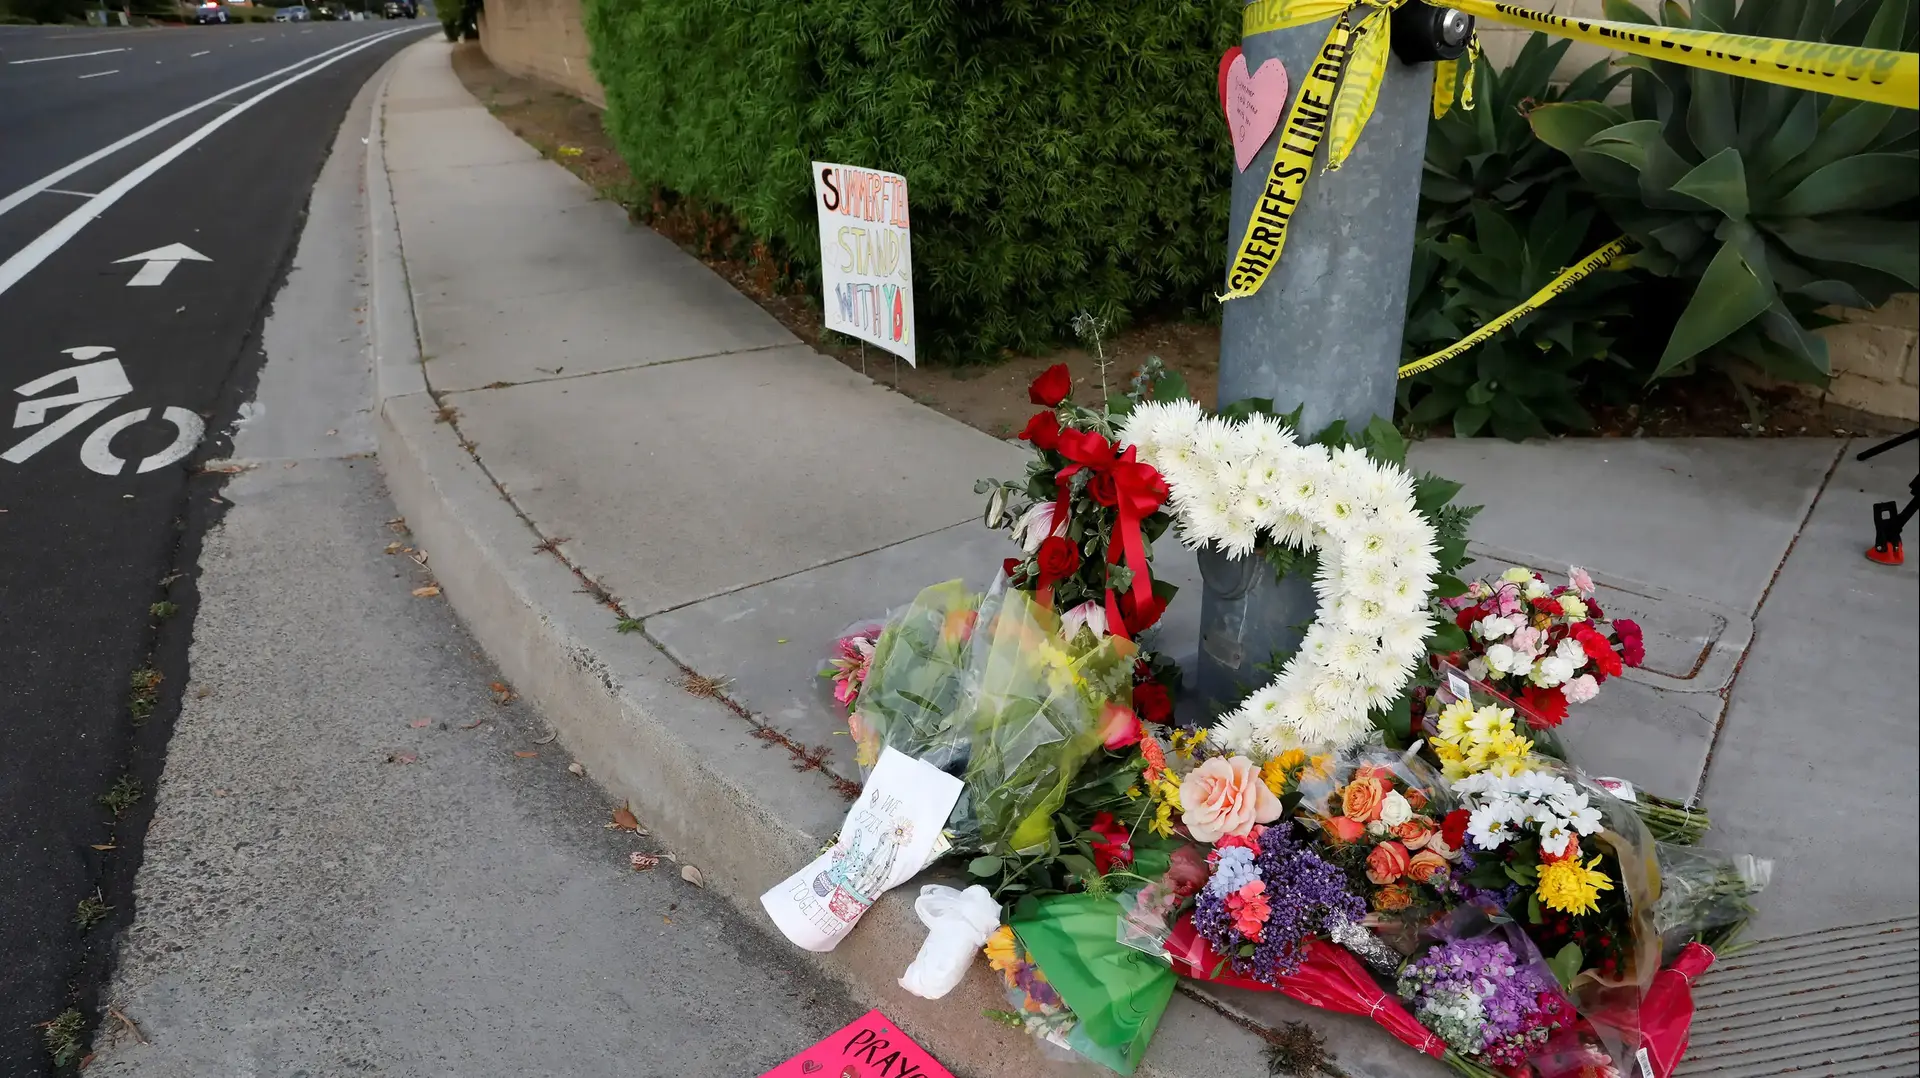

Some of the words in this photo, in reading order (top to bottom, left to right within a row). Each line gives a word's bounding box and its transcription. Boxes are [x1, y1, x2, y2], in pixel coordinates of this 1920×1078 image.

[1231, 162, 1307, 291] SHERIFF'S
[1281, 89, 1329, 158] LINE
[835, 283, 882, 339] WITH
[881, 794, 903, 818] WE
[788, 878, 845, 938] TOGETHER
